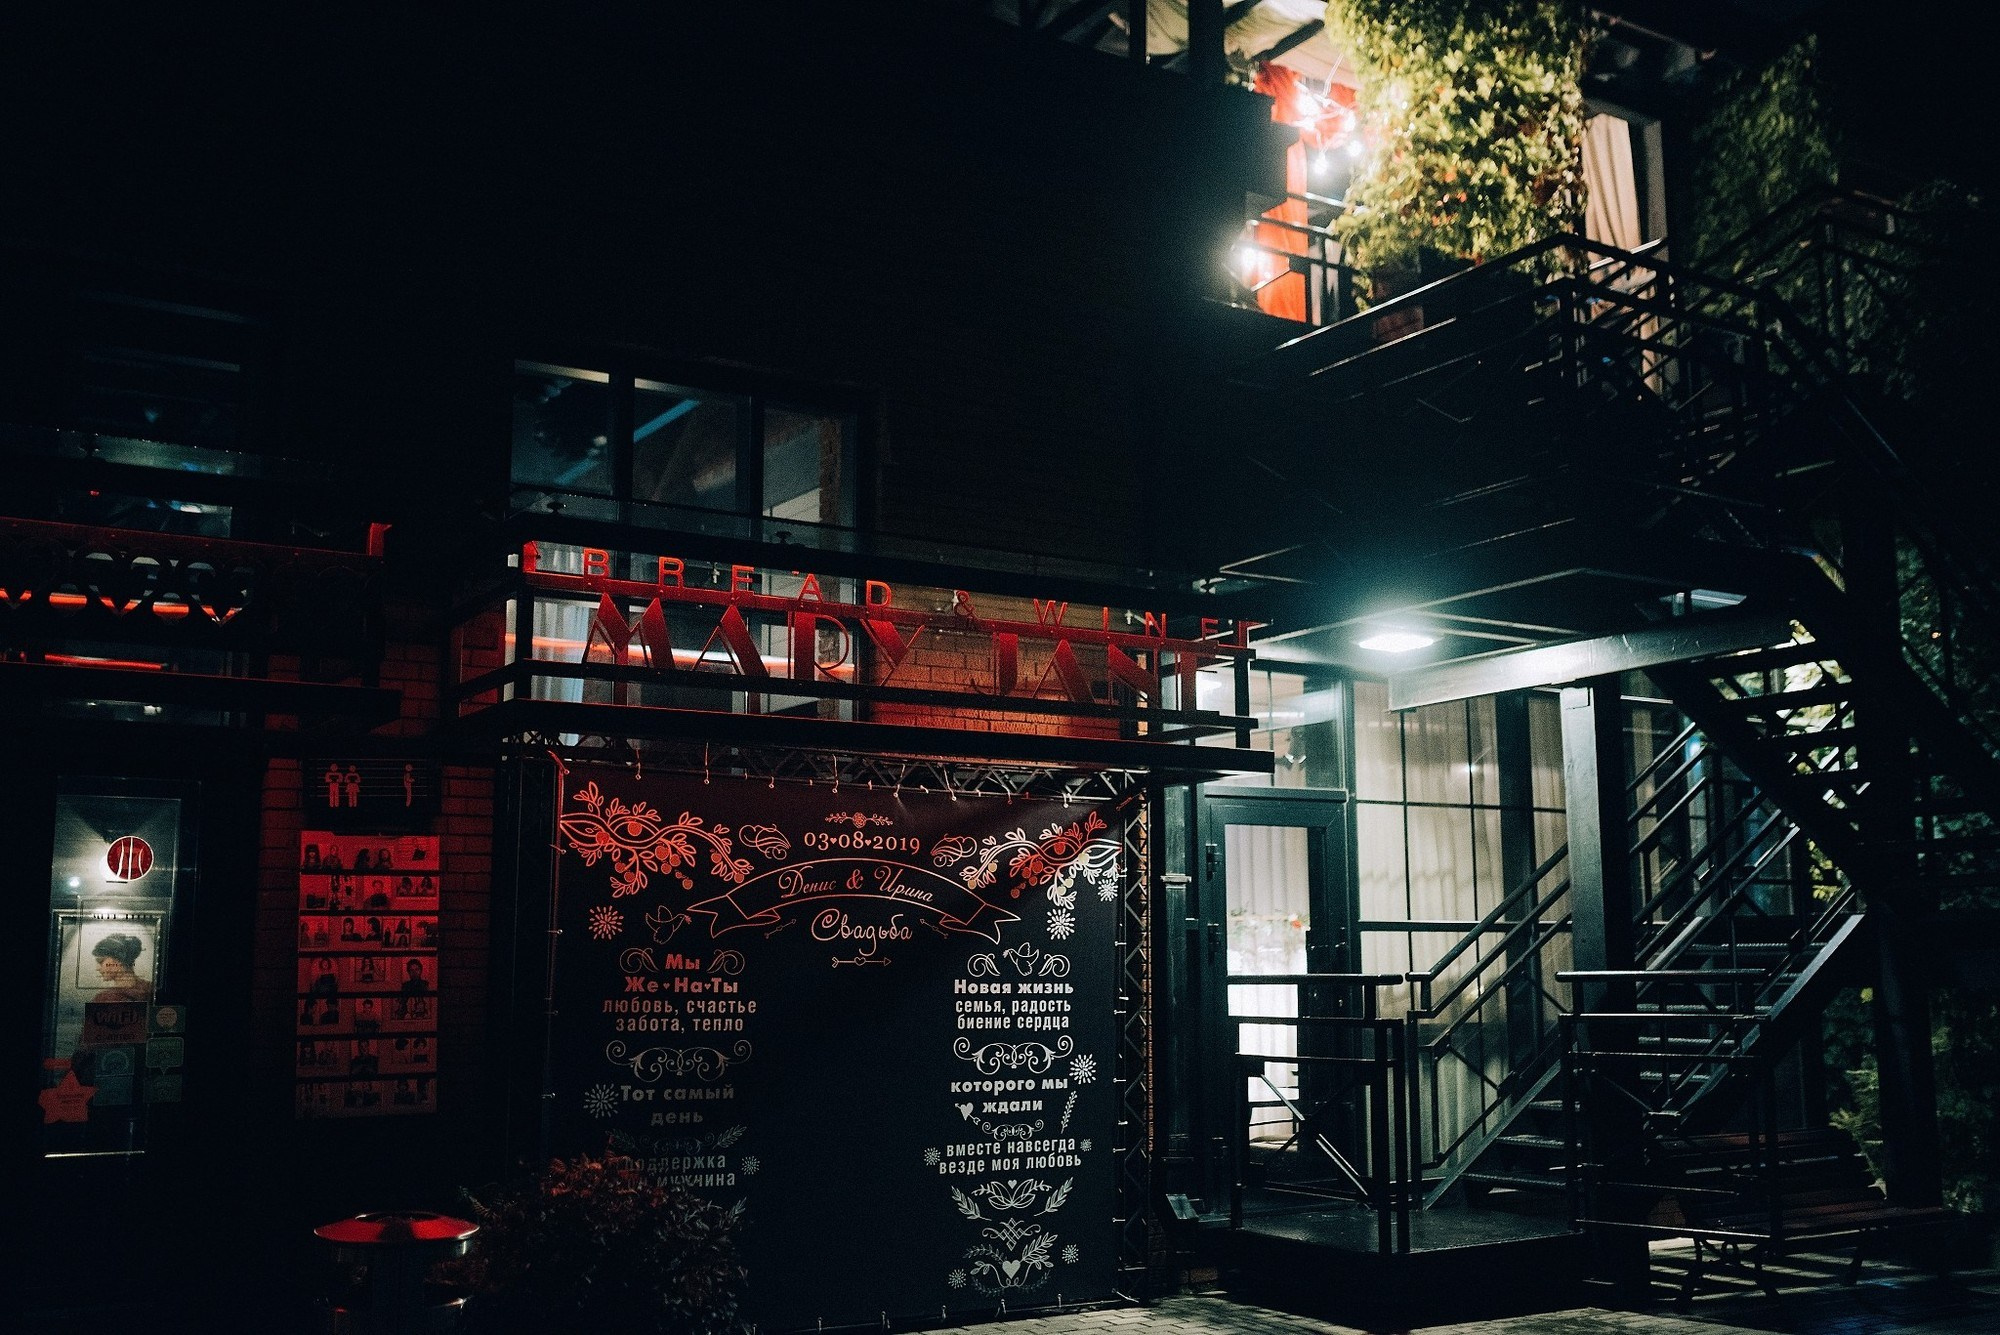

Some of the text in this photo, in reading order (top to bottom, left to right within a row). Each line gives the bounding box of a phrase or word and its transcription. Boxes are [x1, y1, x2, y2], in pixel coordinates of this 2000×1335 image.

[584, 548, 892, 609] BREAD
[1032, 598, 1219, 641] WINE
[581, 592, 925, 690] MARY
[778, 865, 934, 902] Денис & Ирина
[810, 908, 913, 957] Свадьба
[664, 952, 701, 971] Мы
[953, 978, 1075, 995] Новая жизнь
[602, 996, 758, 1016] любовь, счастье
[955, 999, 1072, 1016] семья, радость
[615, 1014, 745, 1034] забота, тепло
[957, 1013, 1070, 1032] биение сердца
[620, 1083, 735, 1101] Тот самый
[950, 1077, 1069, 1097] которого мы
[982, 1099, 1043, 1115] ждали
[650, 1111, 704, 1127] день
[946, 1137, 1076, 1157] вместе навсегда
[938, 1152, 1082, 1176] везде моя любовь
